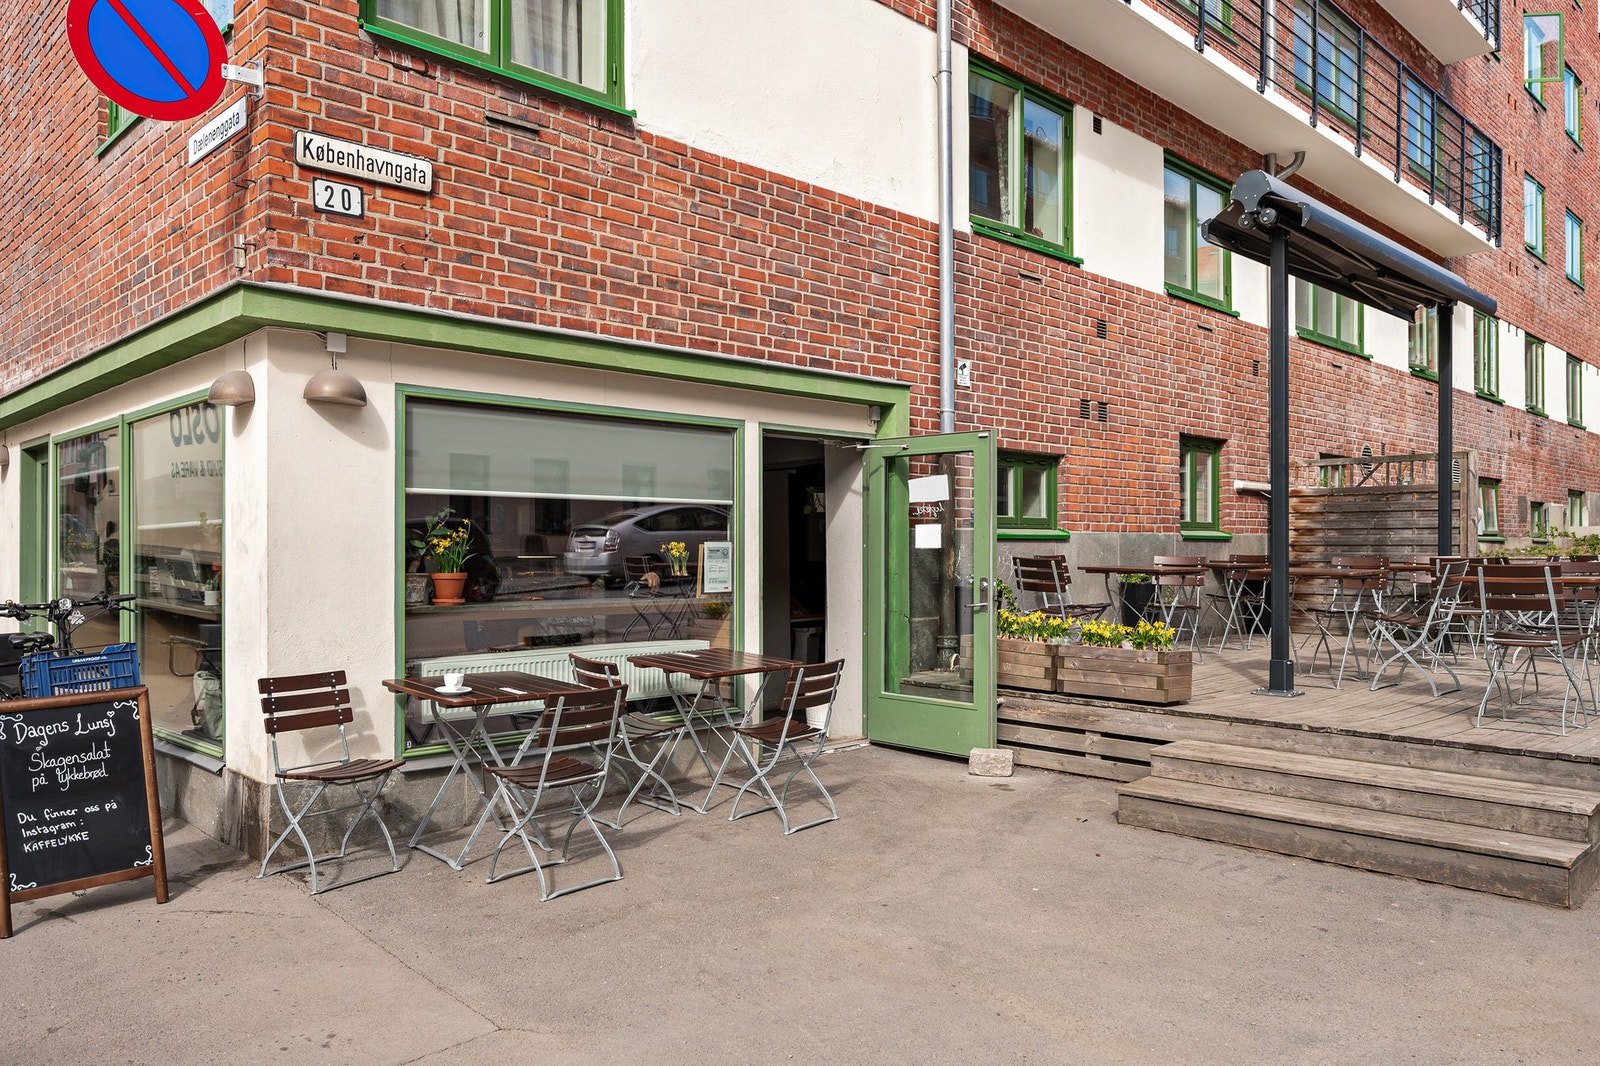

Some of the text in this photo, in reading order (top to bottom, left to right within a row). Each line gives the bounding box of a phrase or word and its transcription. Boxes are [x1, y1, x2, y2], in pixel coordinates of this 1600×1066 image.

[193, 111, 240, 155] Dælenenggata
[303, 137, 426, 184] Københavngata
[324, 185, 352, 211] 20
[13, 711, 116, 746] Dagens Lunsj
[28, 740, 111, 773] Skagensalat
[32, 773, 48, 792] på
[17, 799, 118, 824] Du finner oss på
[23, 831, 90, 853] KAFFELYKKE
